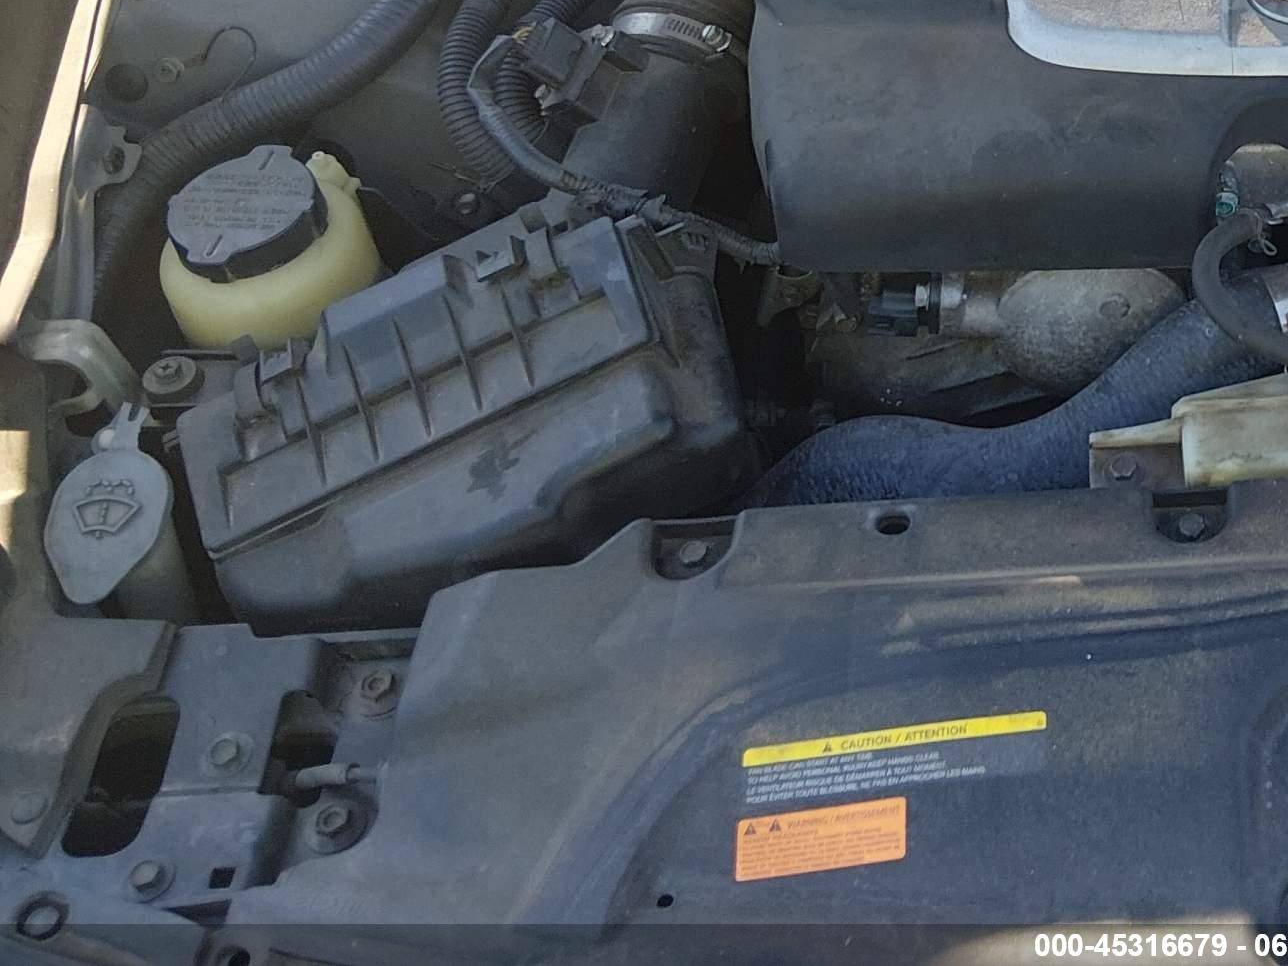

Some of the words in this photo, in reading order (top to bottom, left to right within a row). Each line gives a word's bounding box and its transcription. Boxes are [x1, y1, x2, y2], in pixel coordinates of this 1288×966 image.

[840, 735, 892, 749] CAUTION
[895, 733, 902, 743] /
[903, 723, 968, 742] ATTENTION
[746, 776, 758, 785] TO
[759, 773, 779, 783] HELP
[780, 770, 801, 781] AVOID
[888, 754, 914, 766] HANDS
[746, 786, 756, 795] LE
[834, 774, 844, 783] DE
[893, 764, 912, 775] TOUT
[746, 794, 768, 803] POUR
[795, 786, 818, 798] TOUTE
[872, 778, 888, 787] PAS
[888, 777, 899, 786] EN
[787, 817, 828, 829] WARNING
[834, 805, 900, 825] AVERTISSEMENT
